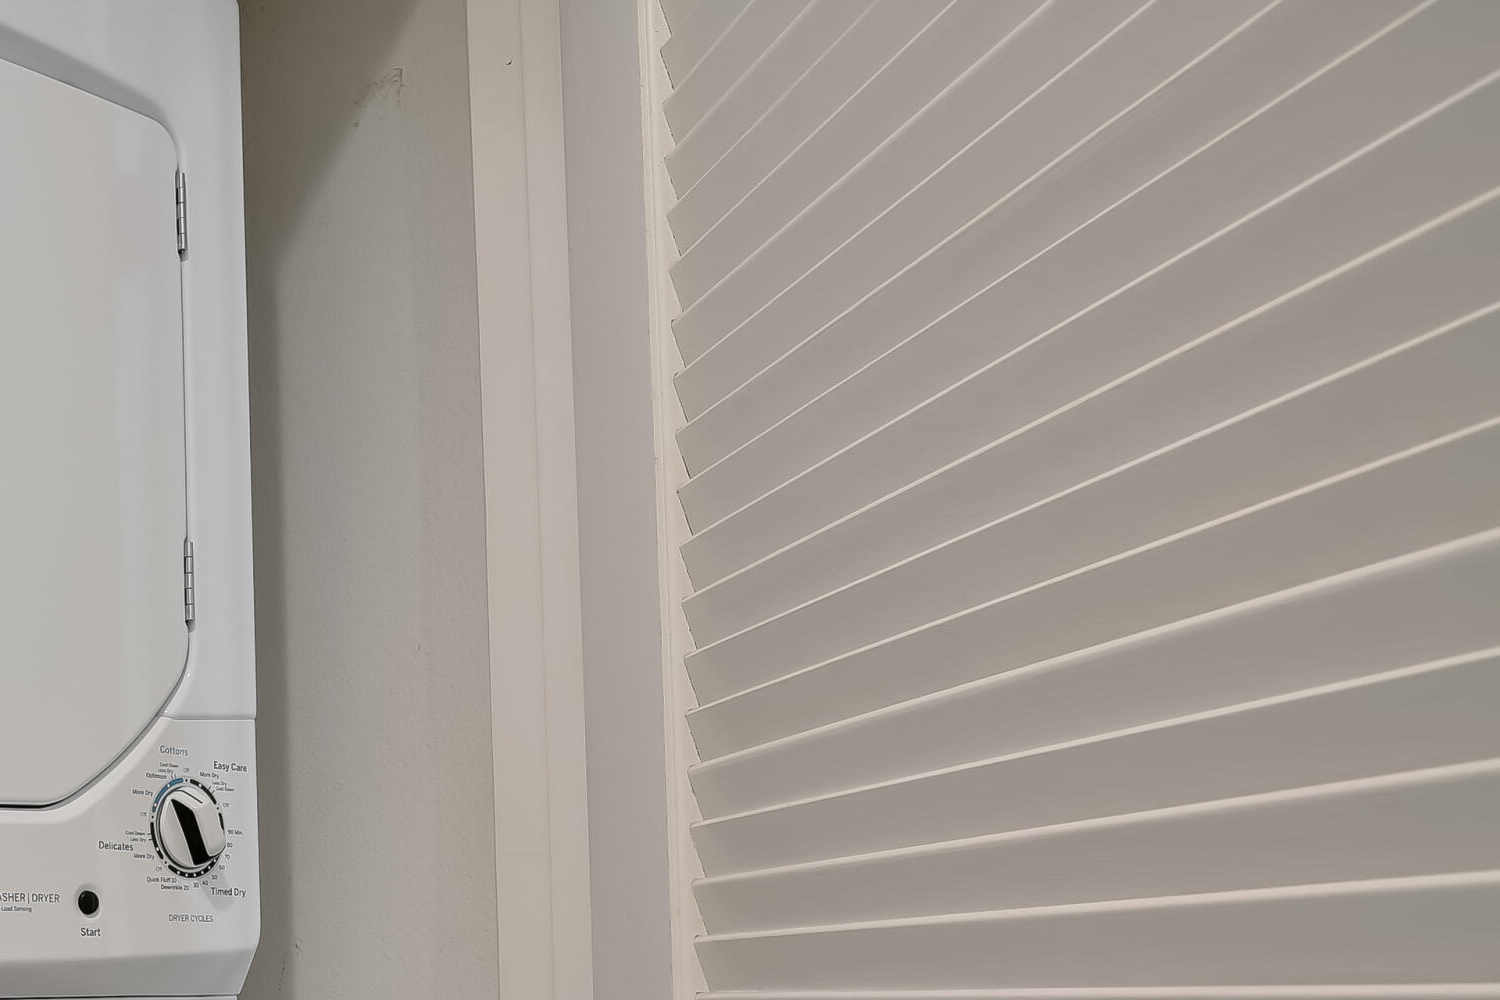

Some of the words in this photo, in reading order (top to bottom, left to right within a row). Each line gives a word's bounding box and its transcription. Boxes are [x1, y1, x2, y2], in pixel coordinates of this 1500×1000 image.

[160, 745, 188, 756] Cottons
[214, 761, 229, 771] Easy
[231, 763, 247, 771] Care
[99, 841, 133, 850] Delicates
[211, 887, 232, 896] Timed
[234, 888, 246, 898] Dry
[32, 894, 60, 902] DRYER
[80, 928, 100, 936] Start
